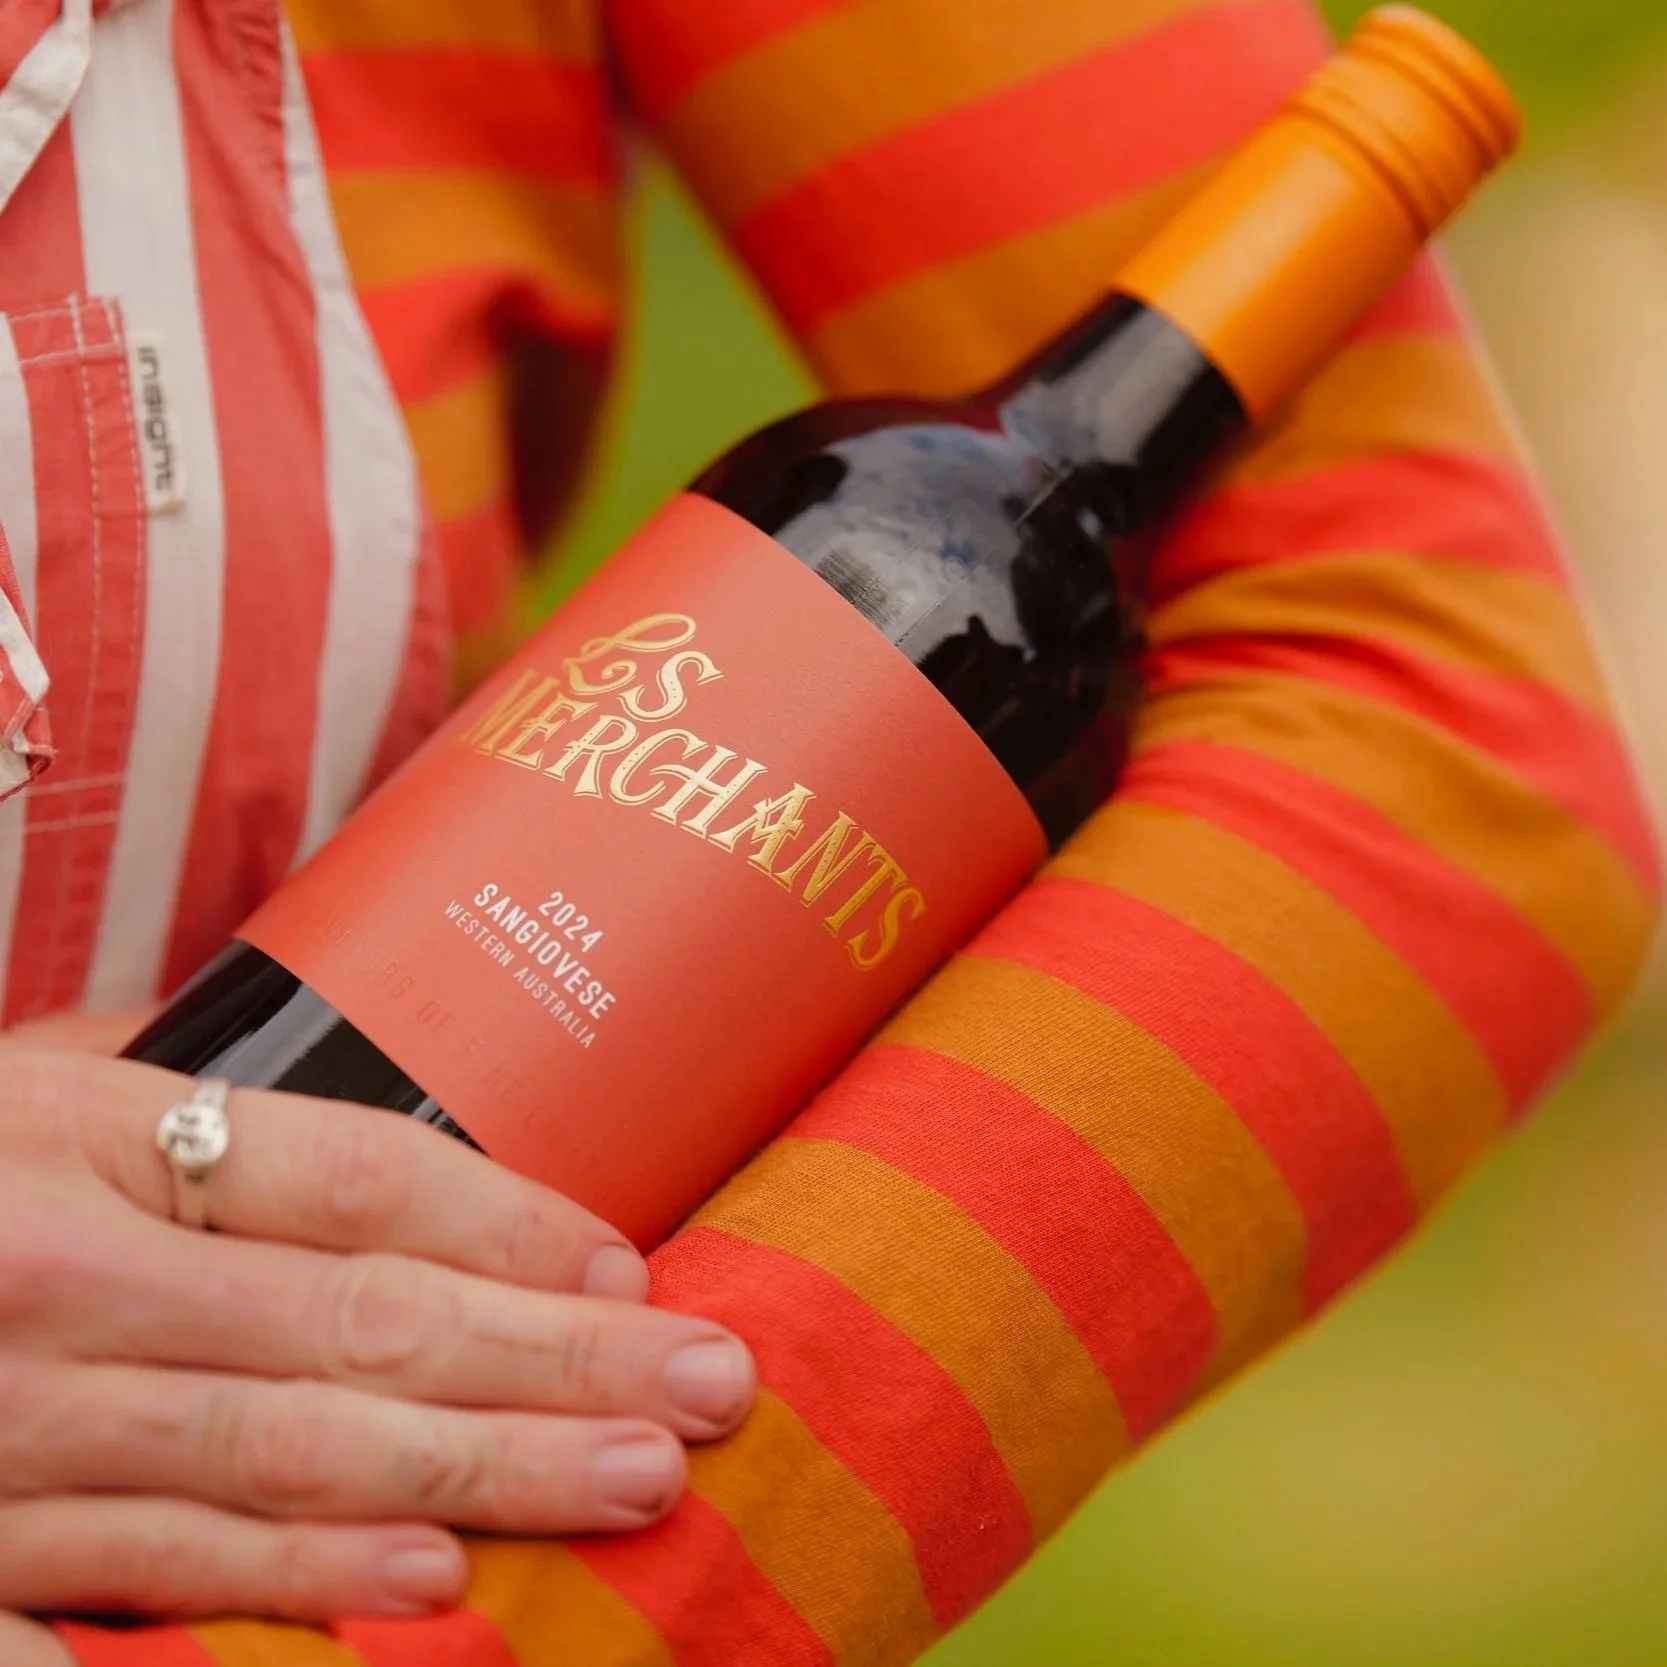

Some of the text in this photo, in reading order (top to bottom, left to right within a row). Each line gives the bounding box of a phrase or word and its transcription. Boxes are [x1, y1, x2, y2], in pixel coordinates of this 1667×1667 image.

[459, 668, 927, 972] MERCHANTS
[444, 900, 595, 1047] WESTERN AUSTRALIA
[473, 883, 615, 1019] SANGIOVESE
[538, 891, 603, 952] 2024
[412, 995, 457, 1039] OF
